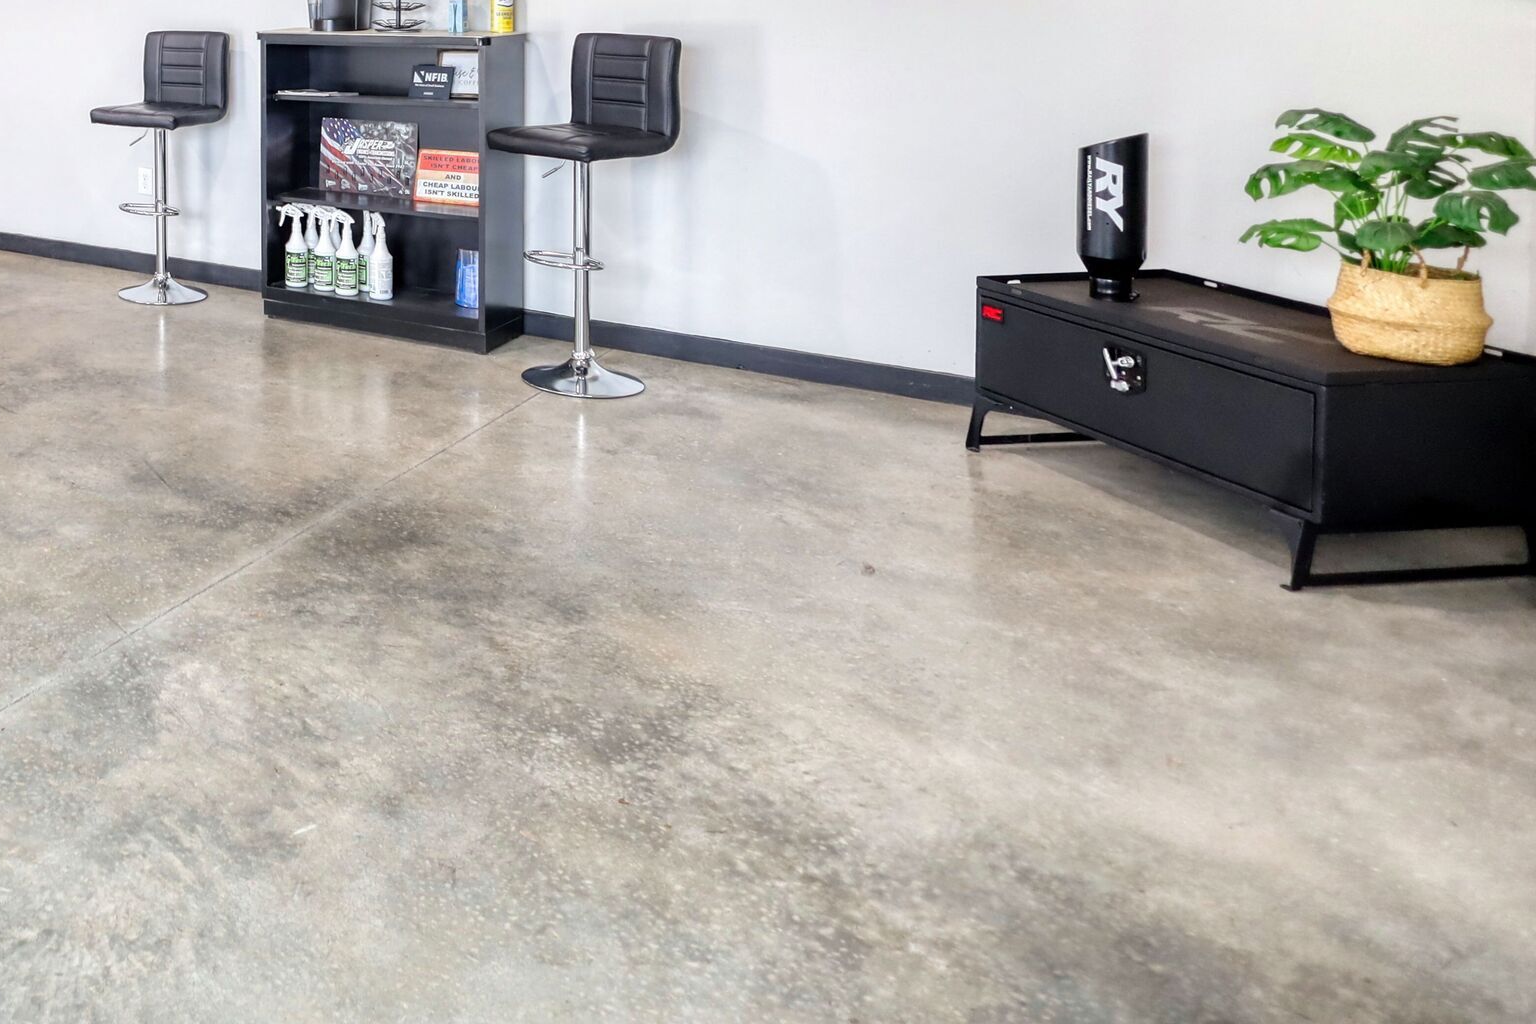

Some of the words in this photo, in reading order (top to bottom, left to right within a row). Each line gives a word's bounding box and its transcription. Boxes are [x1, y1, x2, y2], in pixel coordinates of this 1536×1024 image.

[424, 72, 448, 83] NFIB
[424, 155, 454, 163] SKILLED
[422, 181, 449, 189] CHEAP
[450, 183, 479, 192] LABOU
[424, 188, 445, 196] ISN'T
[446, 190, 480, 199] SKILLED
[1095, 156, 1124, 233] RY
